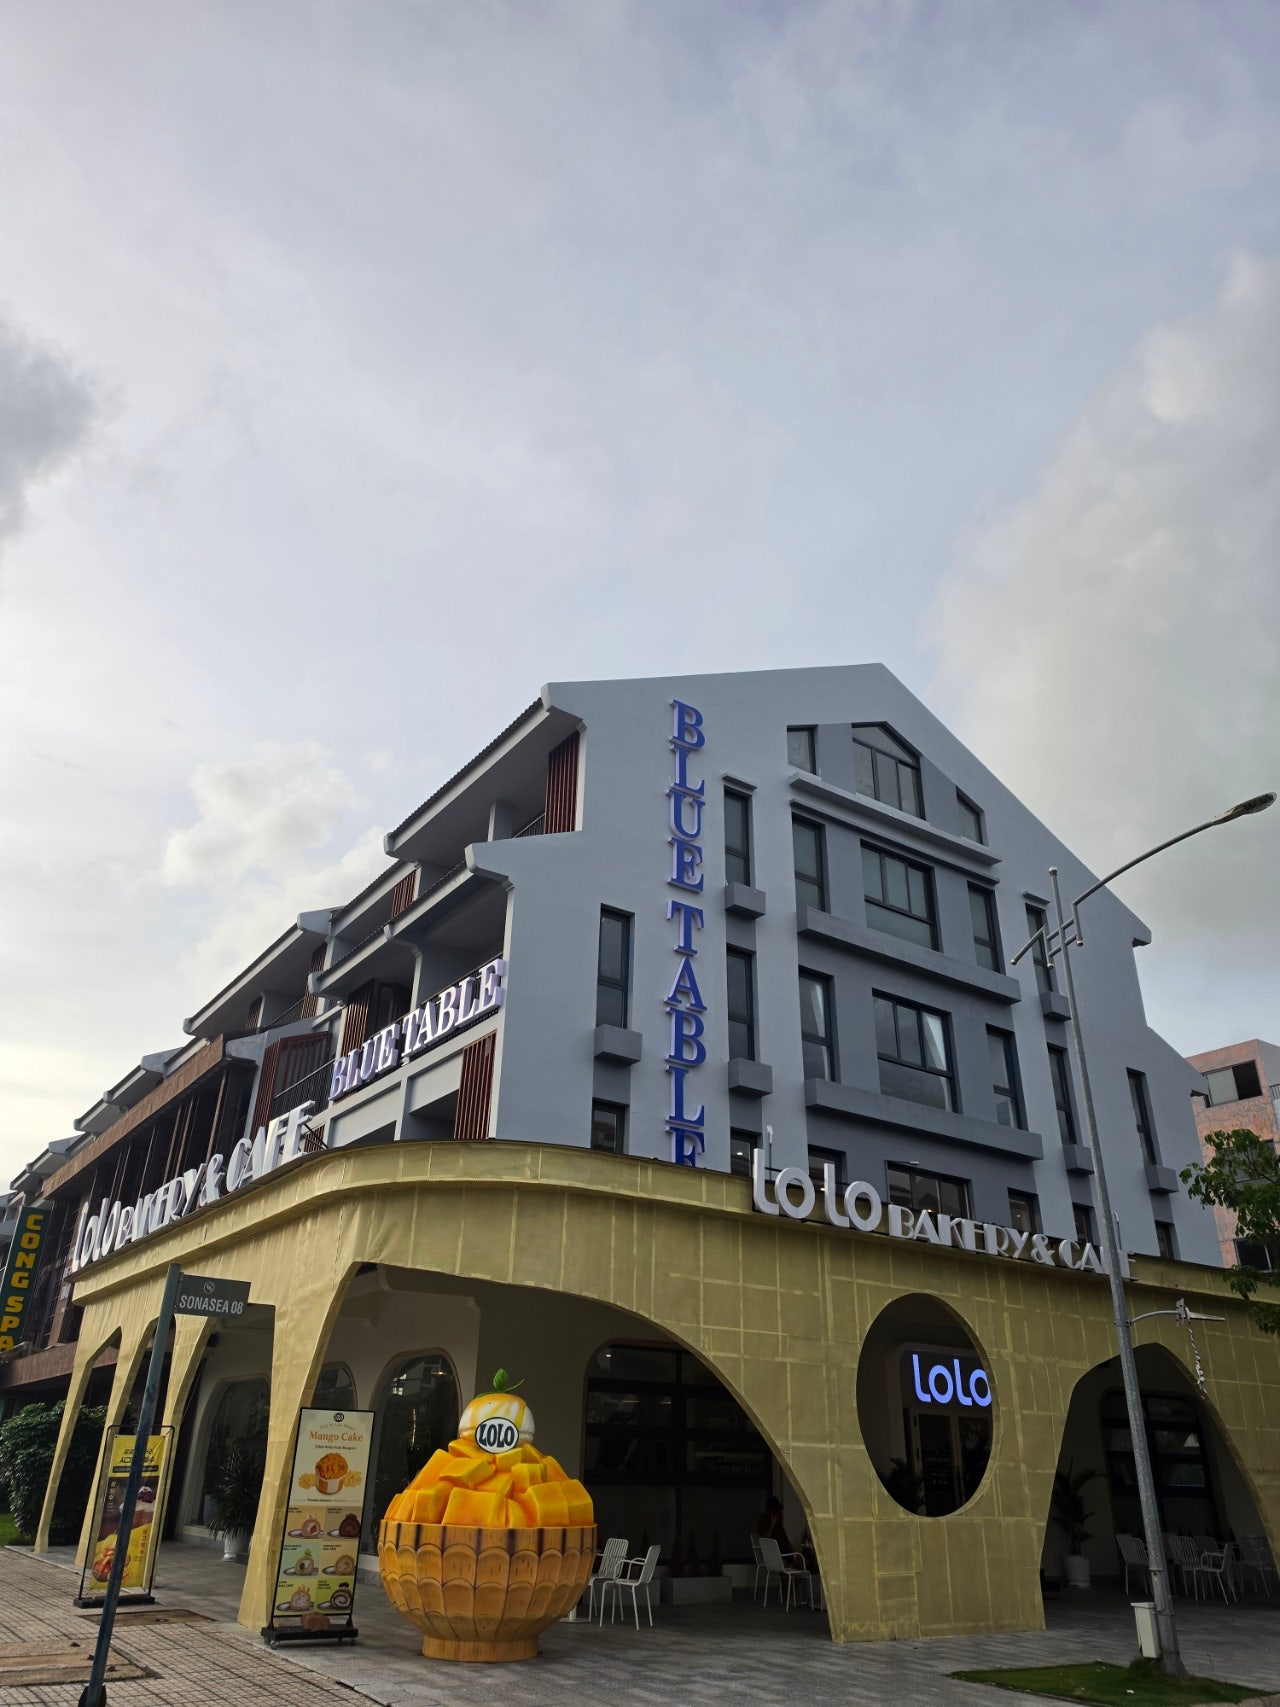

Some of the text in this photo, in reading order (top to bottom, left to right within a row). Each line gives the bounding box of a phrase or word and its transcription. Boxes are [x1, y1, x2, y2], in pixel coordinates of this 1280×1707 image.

[664, 699, 707, 1168] BLUE TABLE
[328, 958, 504, 1101] BLUE TABLE
[114, 1162, 207, 1251] BAKERY
[200, 1153, 225, 1207] &
[226, 1100, 315, 1193] CAFE
[0, 1214, 44, 1351] CONG SPA
[888, 1203, 1029, 1259] BAKERY
[1031, 1233, 1056, 1267] &
[179, 1295, 244, 1315] SONASEA 08
[308, 1430, 363, 1442] Mango Cake
[479, 1423, 515, 1448] LOLO
